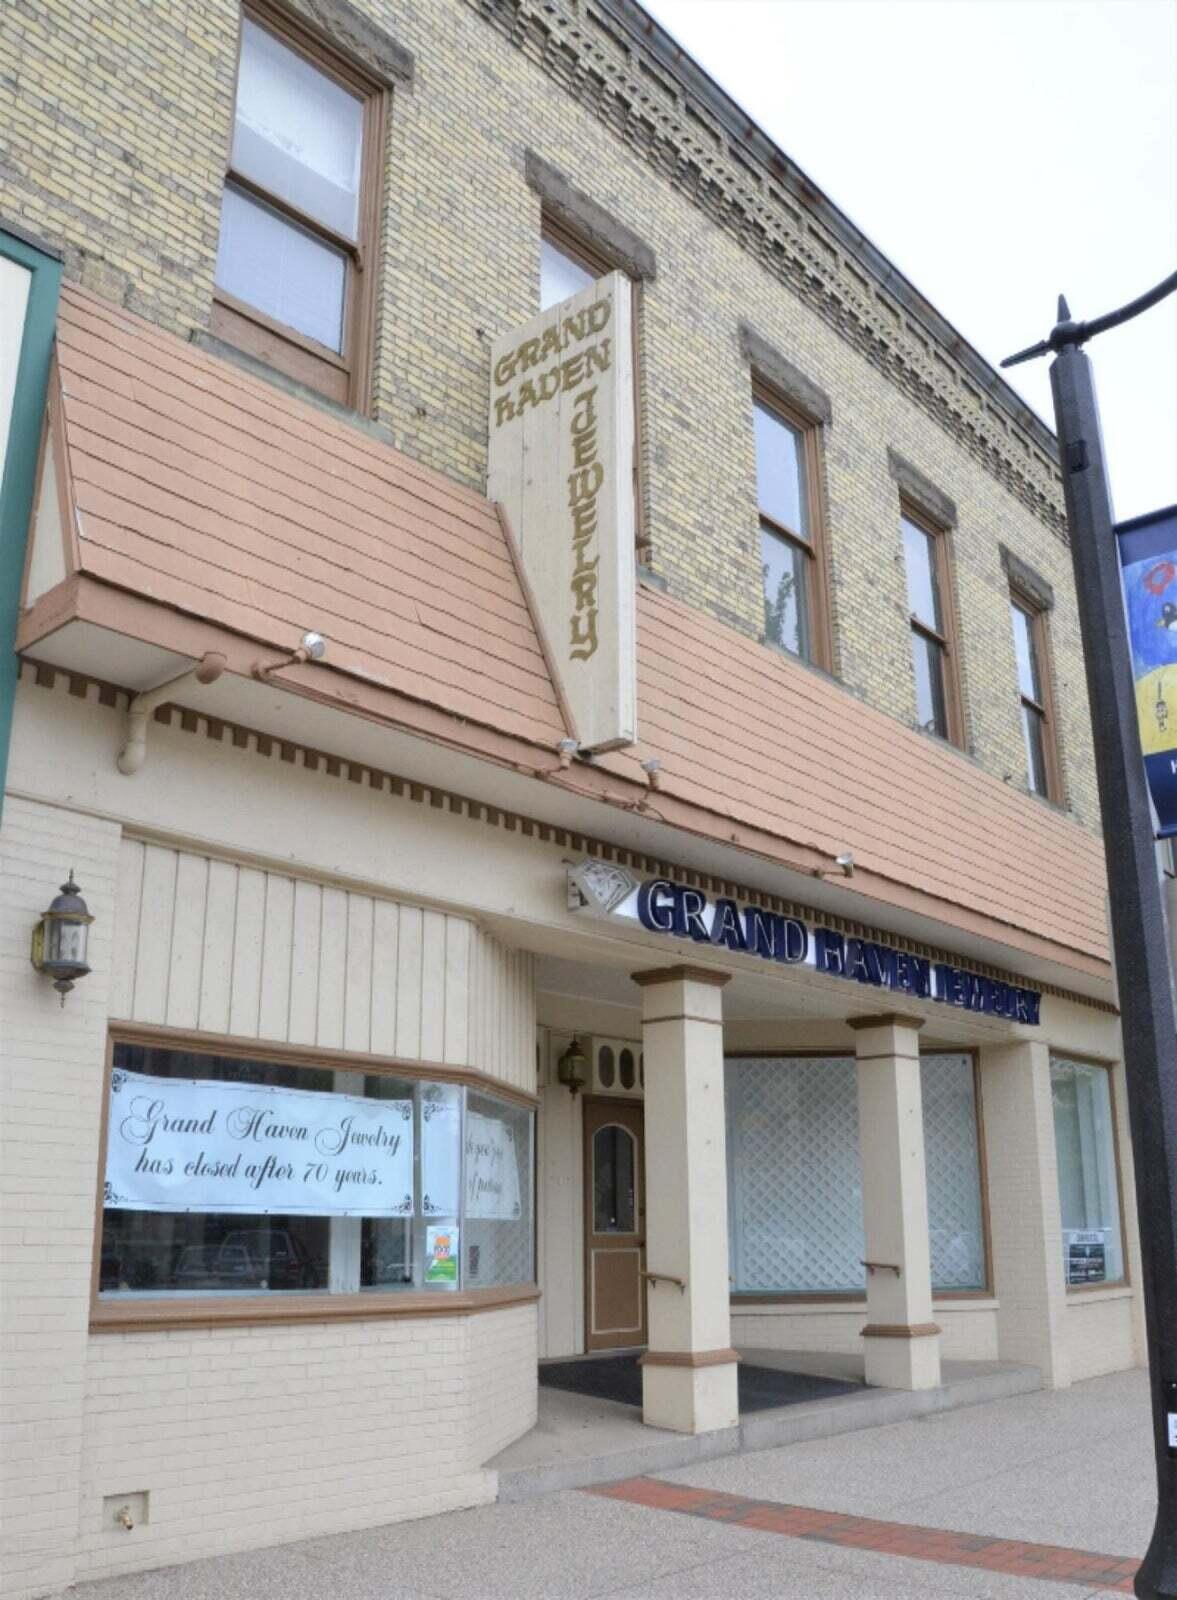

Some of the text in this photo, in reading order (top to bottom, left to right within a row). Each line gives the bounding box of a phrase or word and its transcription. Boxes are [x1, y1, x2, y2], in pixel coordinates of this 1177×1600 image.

[494, 300, 611, 387] GRAND
[568, 385, 604, 661] JEWELRY
[637, 879, 808, 964] GRAND
[815, 928, 930, 998] HAVEN
[120, 1096, 401, 1157] Grand Haven Jewelry
[134, 1147, 383, 1193] has closed after 70 years.
